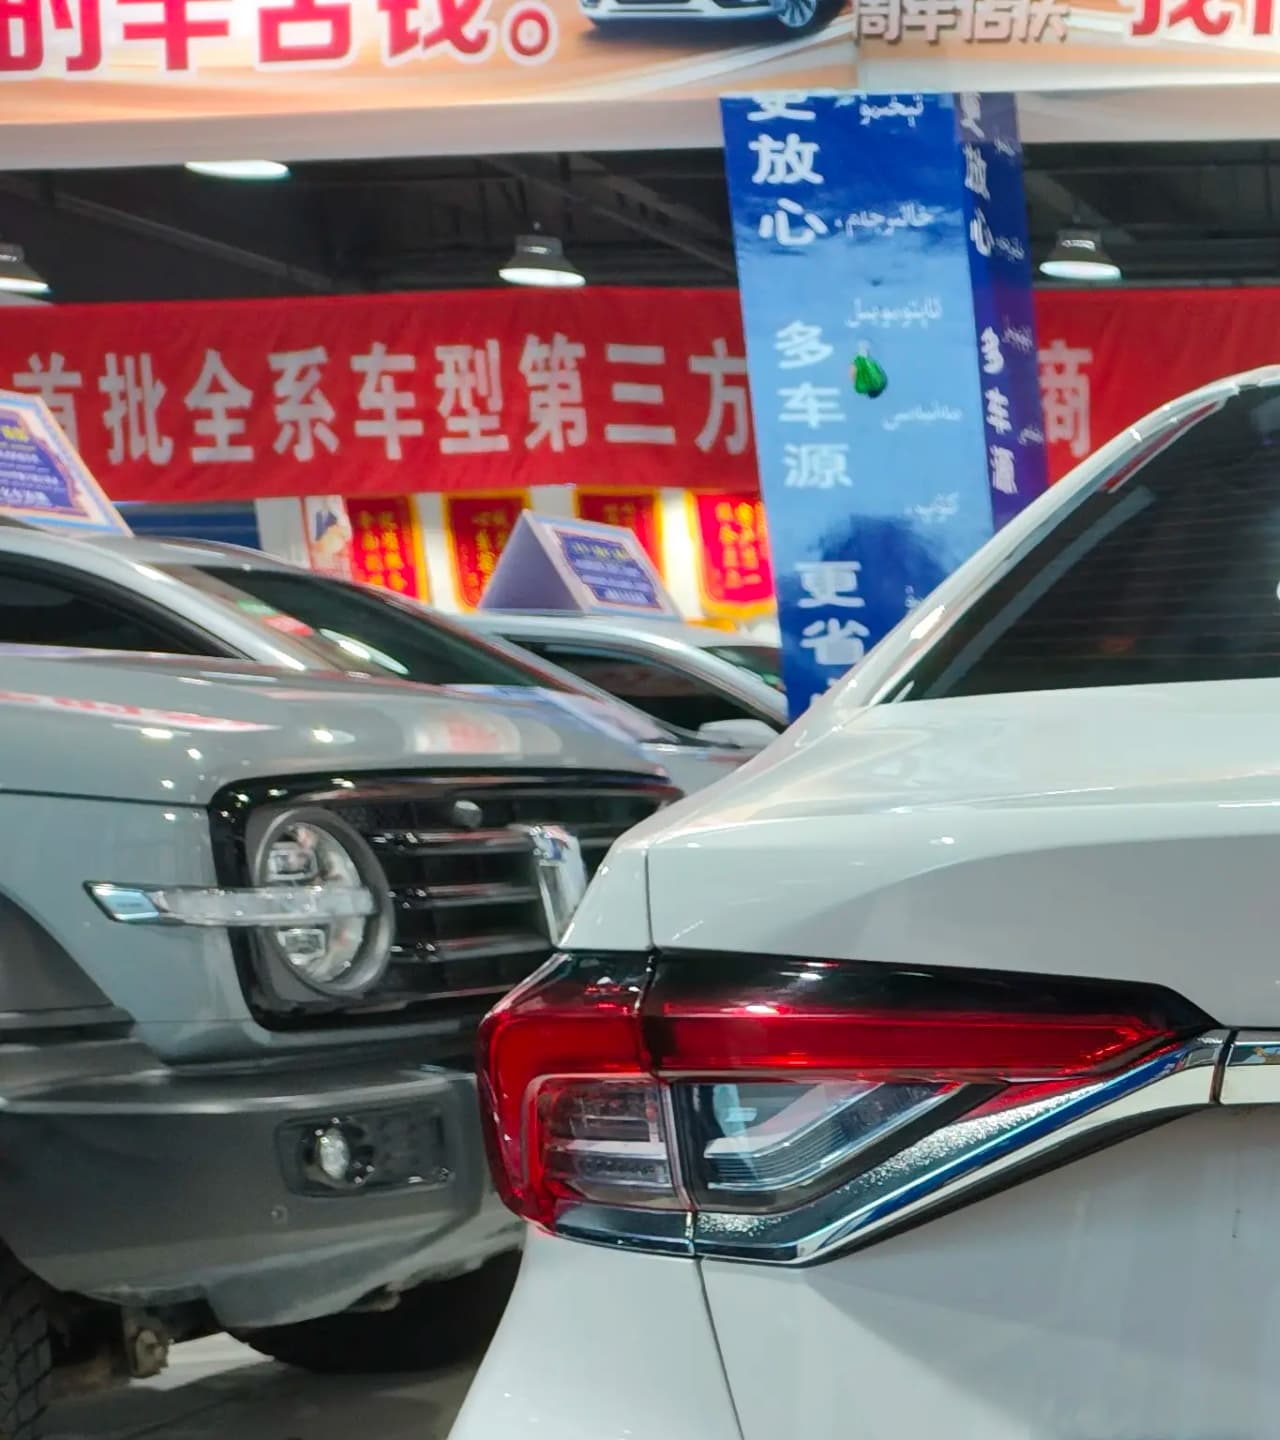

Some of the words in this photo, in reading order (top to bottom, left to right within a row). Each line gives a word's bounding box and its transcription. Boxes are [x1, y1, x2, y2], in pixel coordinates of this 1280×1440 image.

[774, 320, 853, 488] 多车源
[794, 560, 870, 708] 更省
